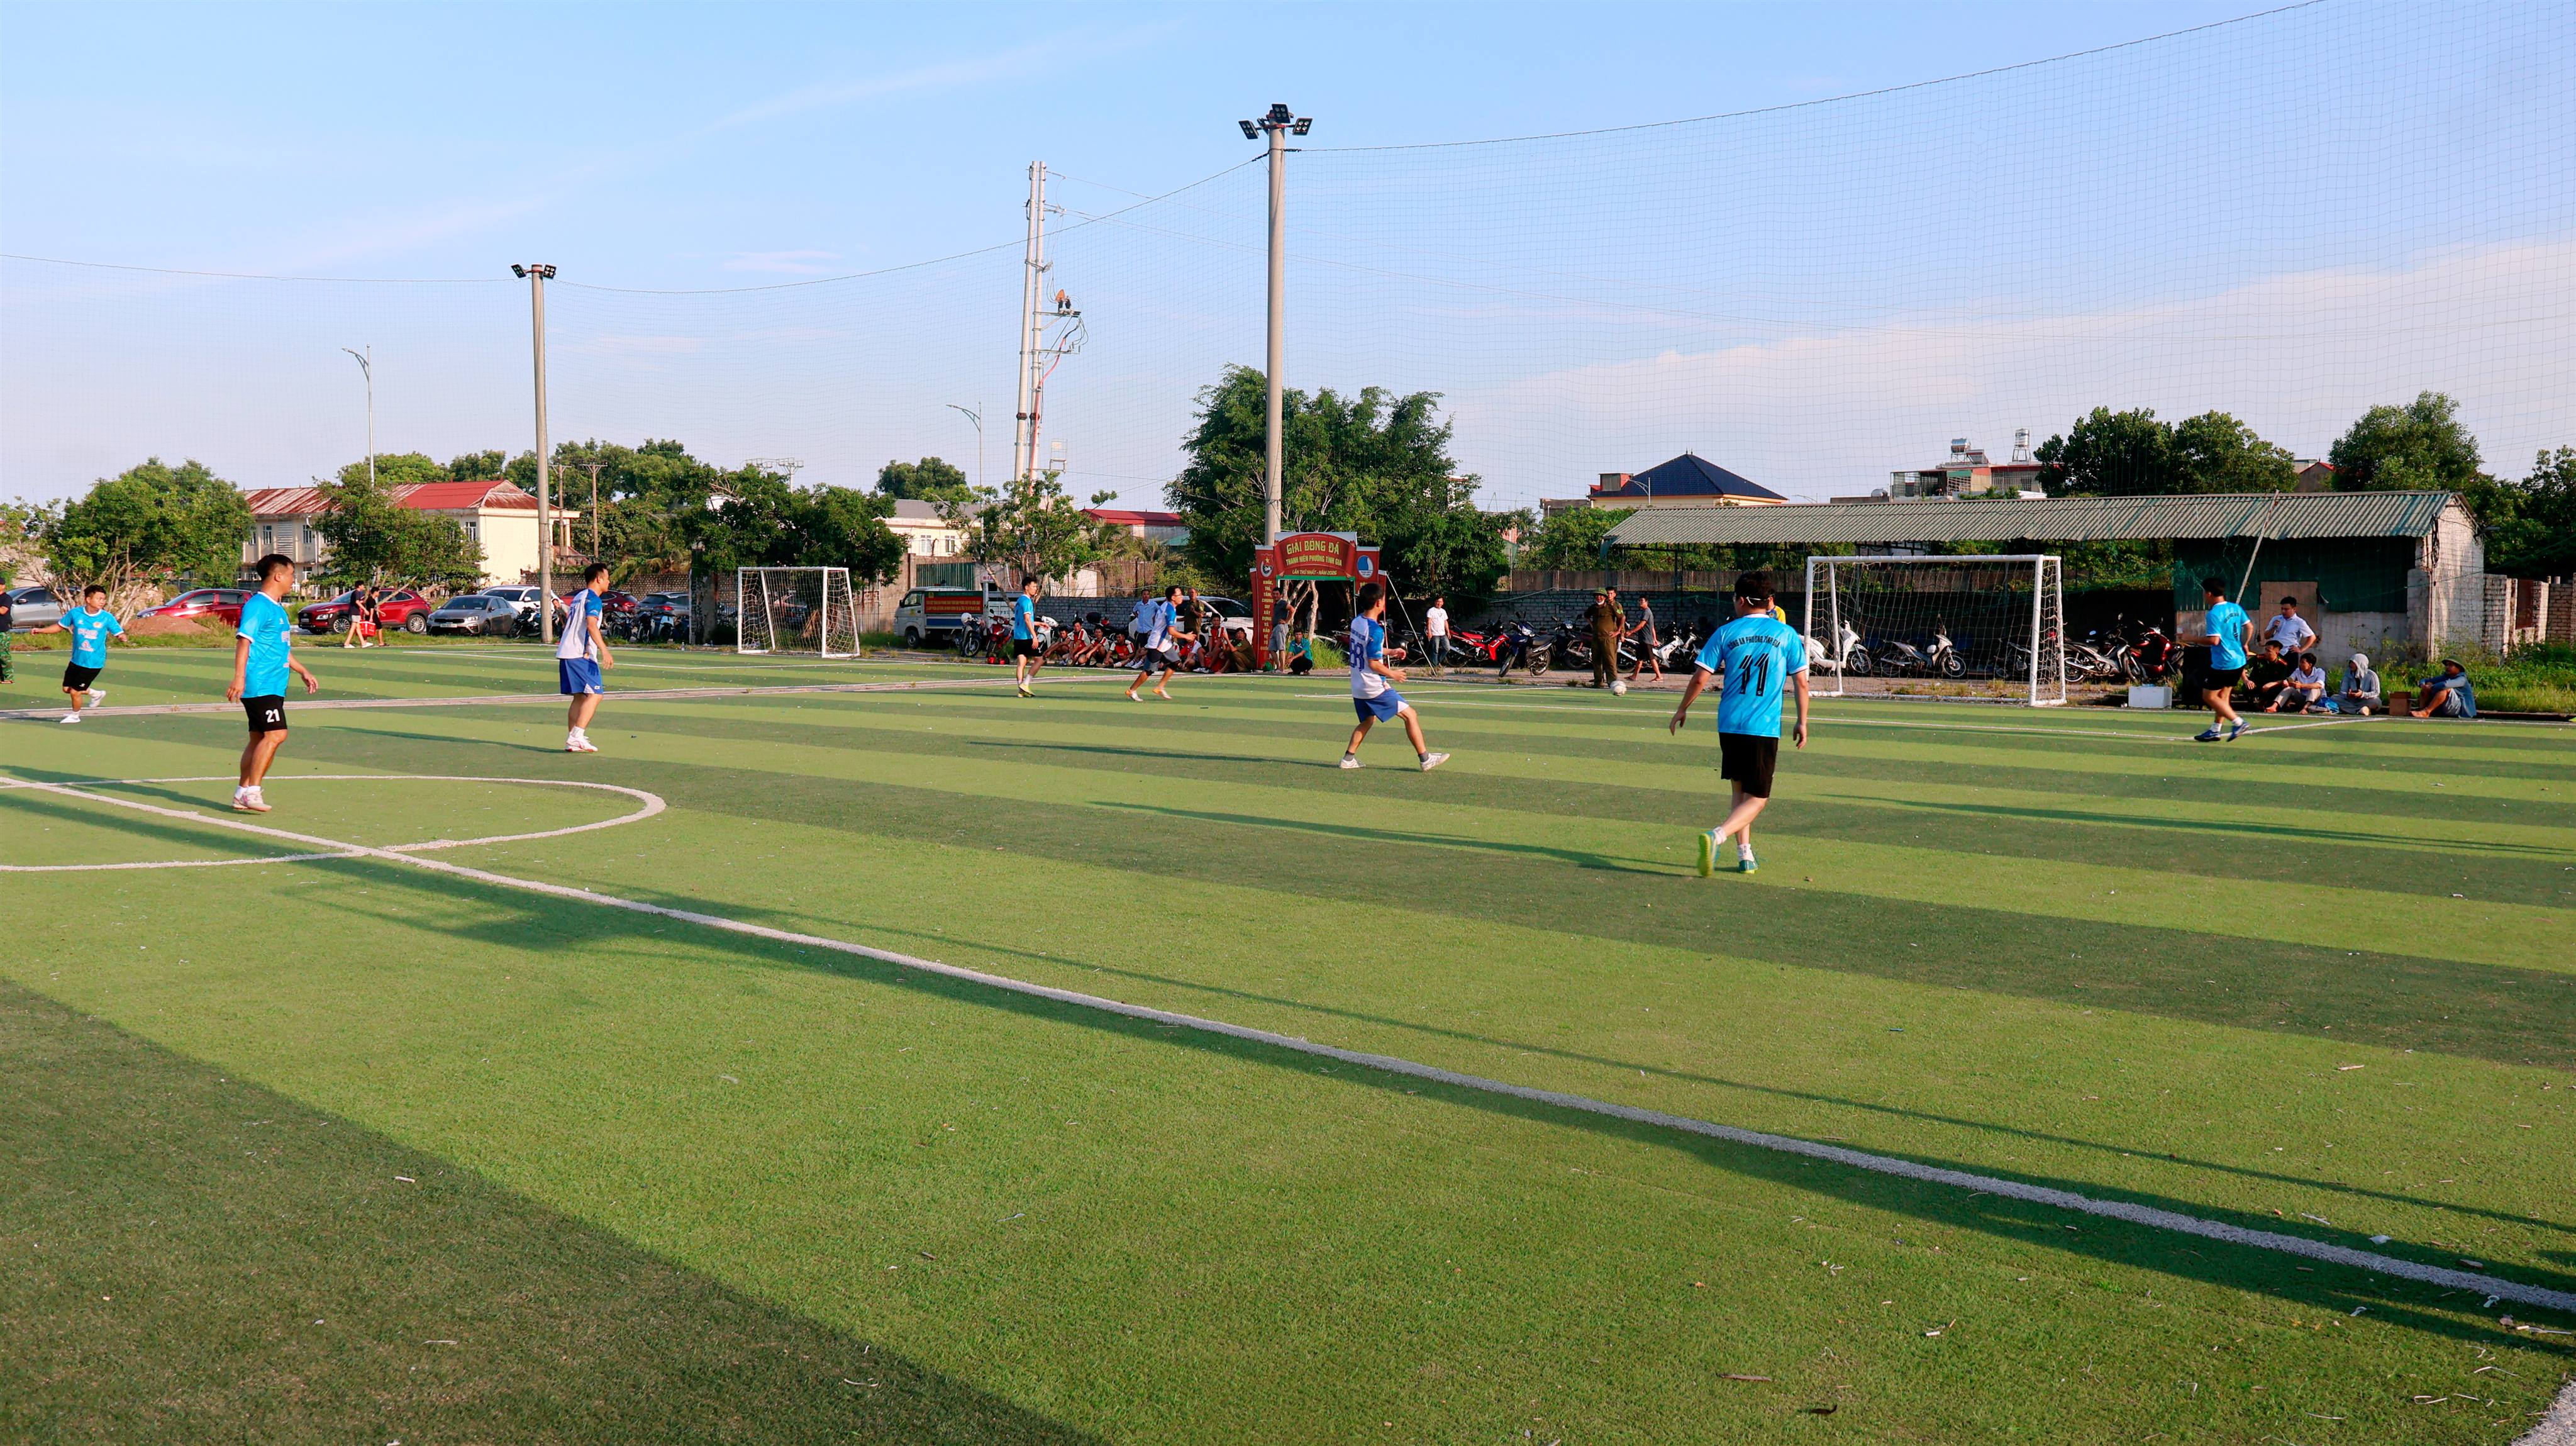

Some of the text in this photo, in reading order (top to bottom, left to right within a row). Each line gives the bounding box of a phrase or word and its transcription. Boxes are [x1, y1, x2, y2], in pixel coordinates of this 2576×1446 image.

[1286, 538, 1340, 555] GIẢI BÓNG ĐÁ
[1286, 557, 1299, 565] THANH
[1299, 554, 1309, 563] NIÊN
[1309, 553, 1324, 562] PHƯỜNG
[1738, 653, 1769, 697] 11
[265, 709, 280, 723] 21
